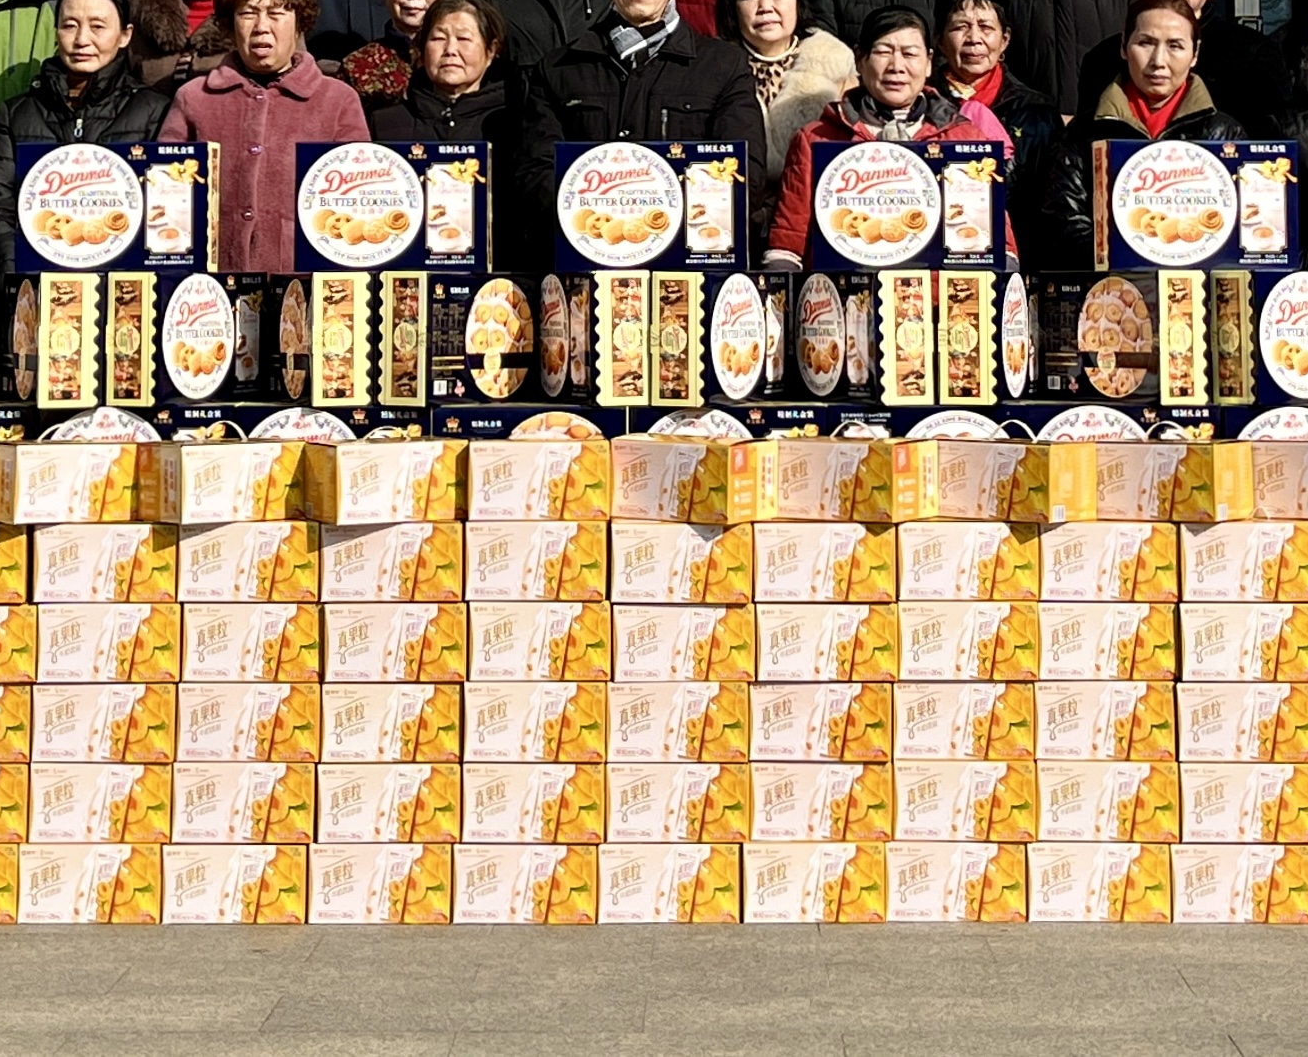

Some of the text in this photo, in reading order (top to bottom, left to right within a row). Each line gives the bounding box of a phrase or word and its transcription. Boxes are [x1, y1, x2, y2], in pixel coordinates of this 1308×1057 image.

[39, 198, 124, 208] BUTTER COOKIES
[319, 198, 404, 208] BUTTER COOKIES
[579, 197, 663, 208] BUTTER COOKIES
[836, 196, 922, 206] BUTTER COOKIES
[1133, 196, 1217, 206] BUTTER COOKIES
